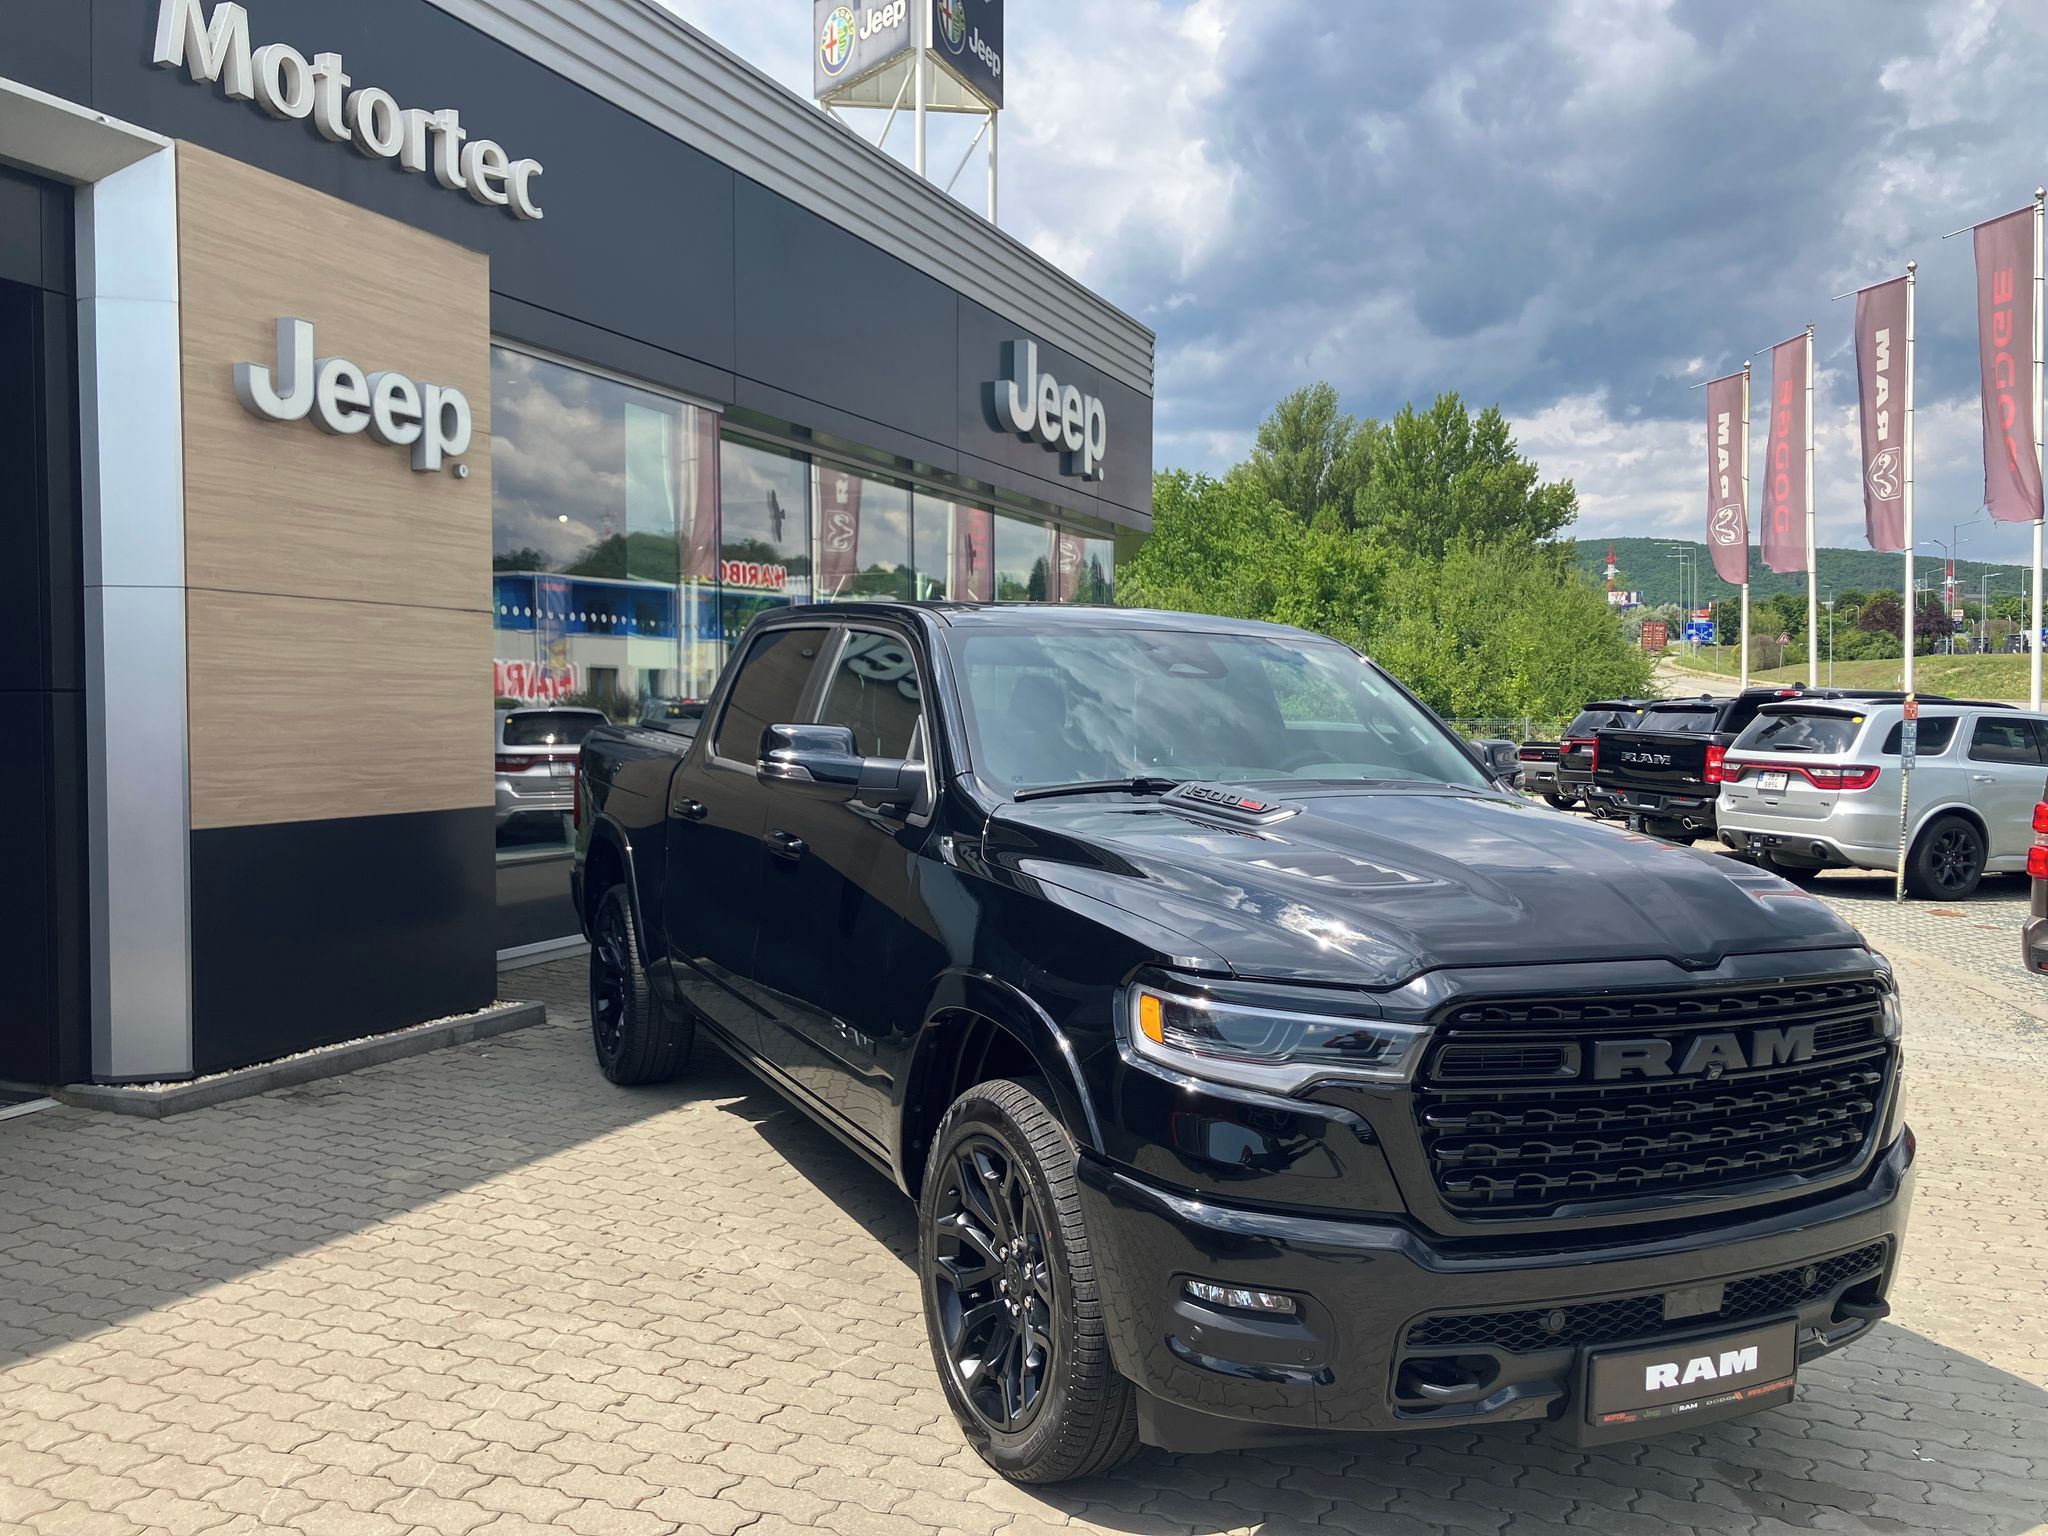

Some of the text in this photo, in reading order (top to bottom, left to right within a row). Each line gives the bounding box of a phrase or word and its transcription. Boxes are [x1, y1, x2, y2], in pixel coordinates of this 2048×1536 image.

[859, 0, 906, 40] Jeep
[968, 27, 1001, 78] Jeep
[153, 0, 543, 219] Motortec
[233, 317, 472, 473] Jeep
[994, 339, 1106, 476] Jeep
[1621, 751, 1672, 766] RAM
[1186, 785, 1242, 806] 1500
[1594, 1024, 1816, 1080] RAM
[1645, 1346, 1758, 1391] RAM
[1679, 1402, 1698, 1411] RAM
